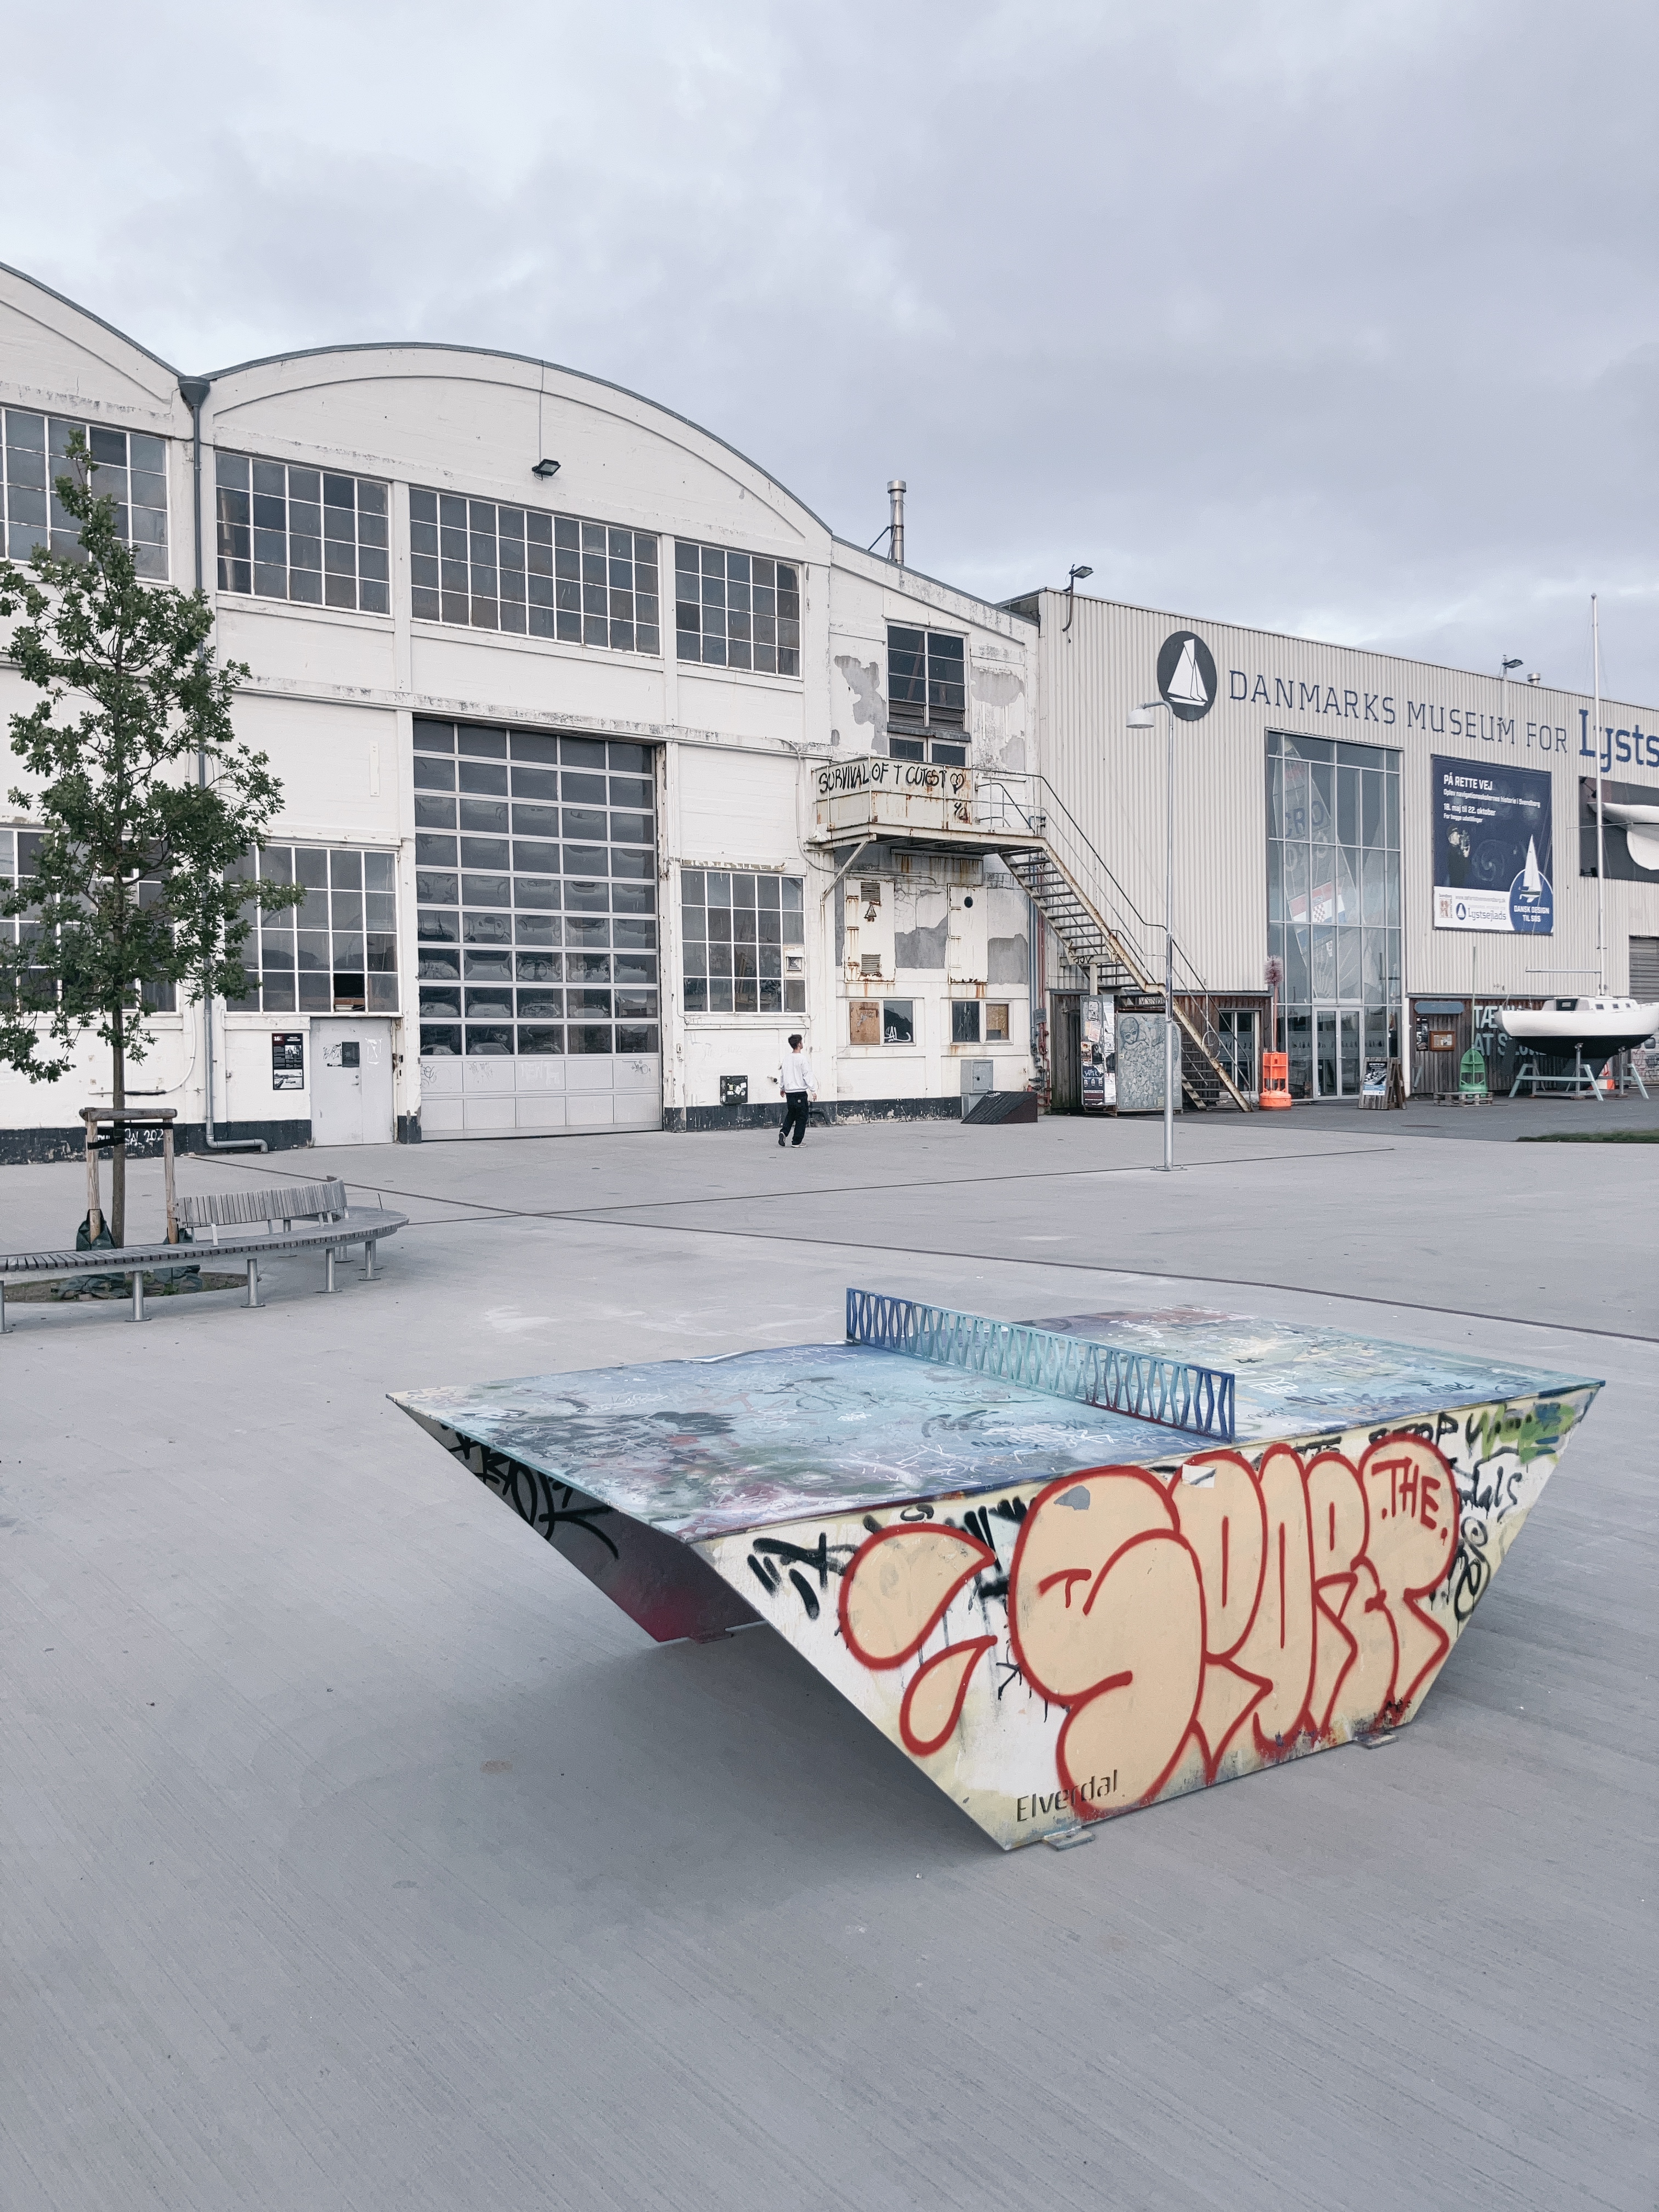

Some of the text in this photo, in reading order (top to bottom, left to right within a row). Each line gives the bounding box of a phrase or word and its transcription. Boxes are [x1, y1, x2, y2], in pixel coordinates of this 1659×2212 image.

[1229, 670, 1395, 724] DANMARKS
[1407, 701, 1515, 745] MUSEUM
[1526, 721, 1567, 754] FOR
[819, 764, 869, 793] SURVIVAL
[871, 762, 889, 784] OF
[1443, 771, 1493, 791] PÅ RETTE VEJ
[1451, 804, 1461, 814] maj
[1476, 807, 1496, 816] oktober
[1519, 798, 1541, 809] Svendborg
[1468, 908, 1506, 922] Lystsejlads
[1017, 1768, 1118, 1823] Elverdal
